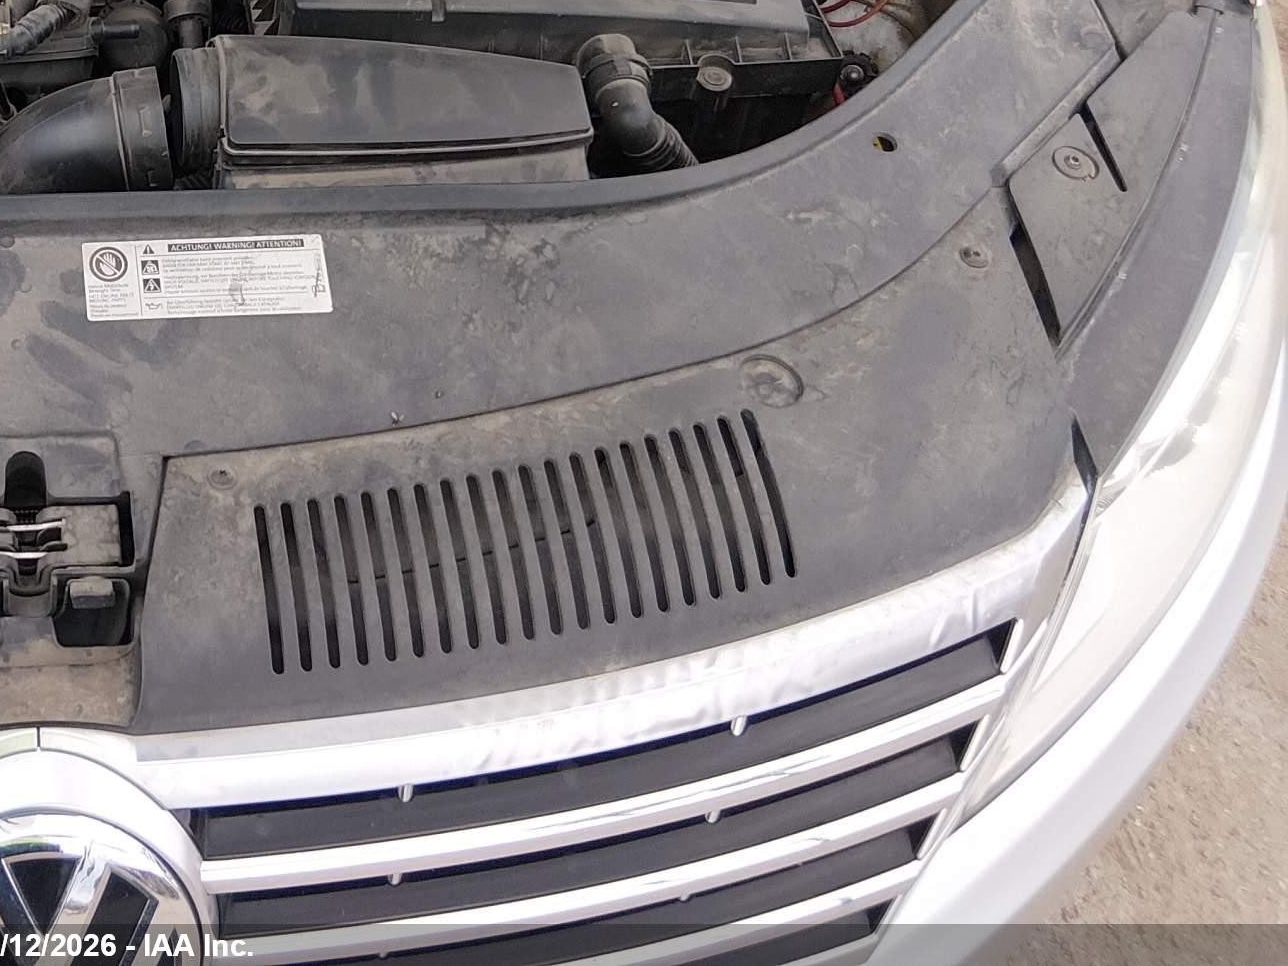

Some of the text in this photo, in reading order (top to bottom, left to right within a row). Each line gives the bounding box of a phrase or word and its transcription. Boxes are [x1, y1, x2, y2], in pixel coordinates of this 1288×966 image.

[170, 239, 302, 252] ACHTUNG! WARNING! ATTENTION!
